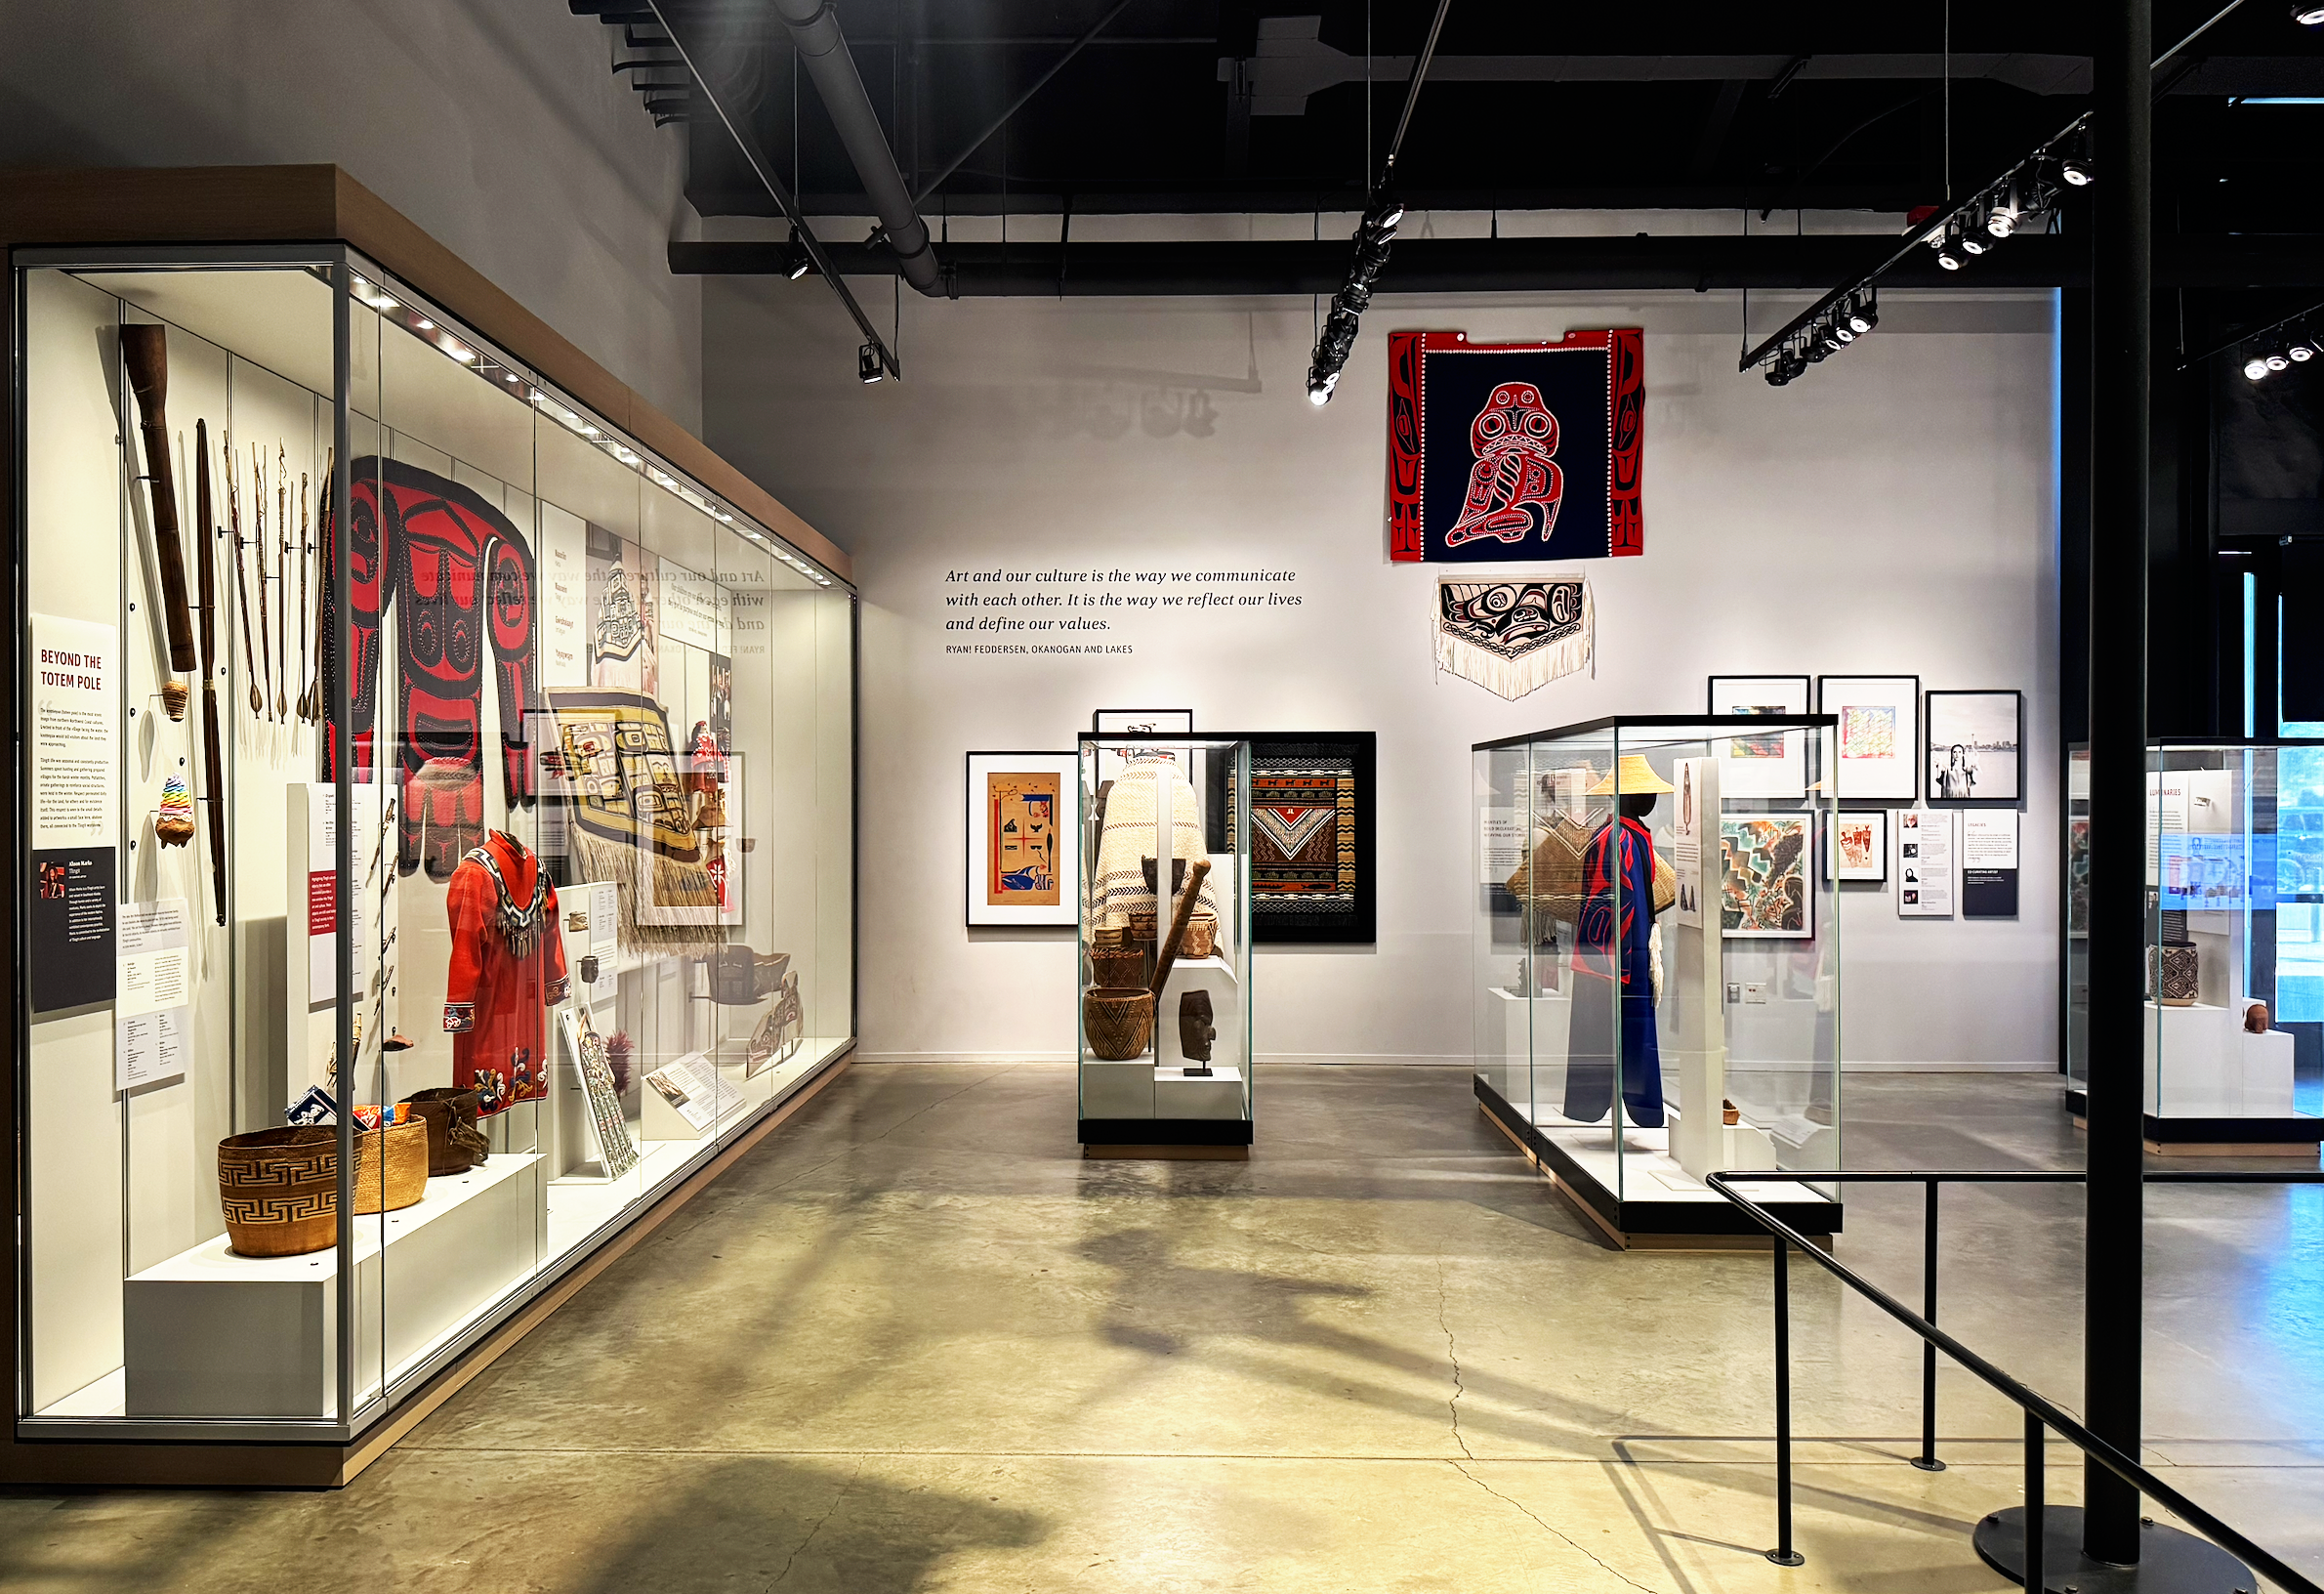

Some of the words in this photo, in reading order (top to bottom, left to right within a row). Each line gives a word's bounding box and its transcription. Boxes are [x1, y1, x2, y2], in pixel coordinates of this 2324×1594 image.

[944, 568, 969, 582] Art
[973, 568, 1002, 582] and
[1006, 572, 1032, 582] our
[1035, 568, 1088, 582] culture
[1091, 568, 1104, 582] is
[1108, 568, 1132, 582] the
[1135, 572, 1167, 585] way
[1171, 571, 1192, 582] we
[1195, 568, 1296, 582] communicate
[945, 592, 978, 607] with
[982, 592, 1017, 607] each
[1021, 592, 1062, 607] other.
[1067, 593, 1079, 607] It
[1083, 593, 1096, 607] is
[1100, 592, 1123, 607] the
[1126, 596, 1158, 609] way
[1162, 596, 1183, 607] we
[1186, 592, 1235, 609] reflect
[1238, 596, 1265, 606] our
[1267, 591, 1303, 606] lives
[945, 615, 975, 630] and
[978, 615, 1025, 633] define
[1028, 620, 1056, 630] our
[1058, 615, 1110, 630] values.
[41, 649, 81, 667] BEYOND
[84, 655, 101, 669] THE
[945, 645, 972, 654] RYAN!
[974, 645, 1029, 655] FEDDERSEN,
[1031, 645, 1082, 654] OKANOGAN
[1084, 645, 1103, 654] AND
[1105, 645, 1133, 654] LAKES
[41, 671, 74, 688] TOTEM
[77, 675, 101, 690] POLE
